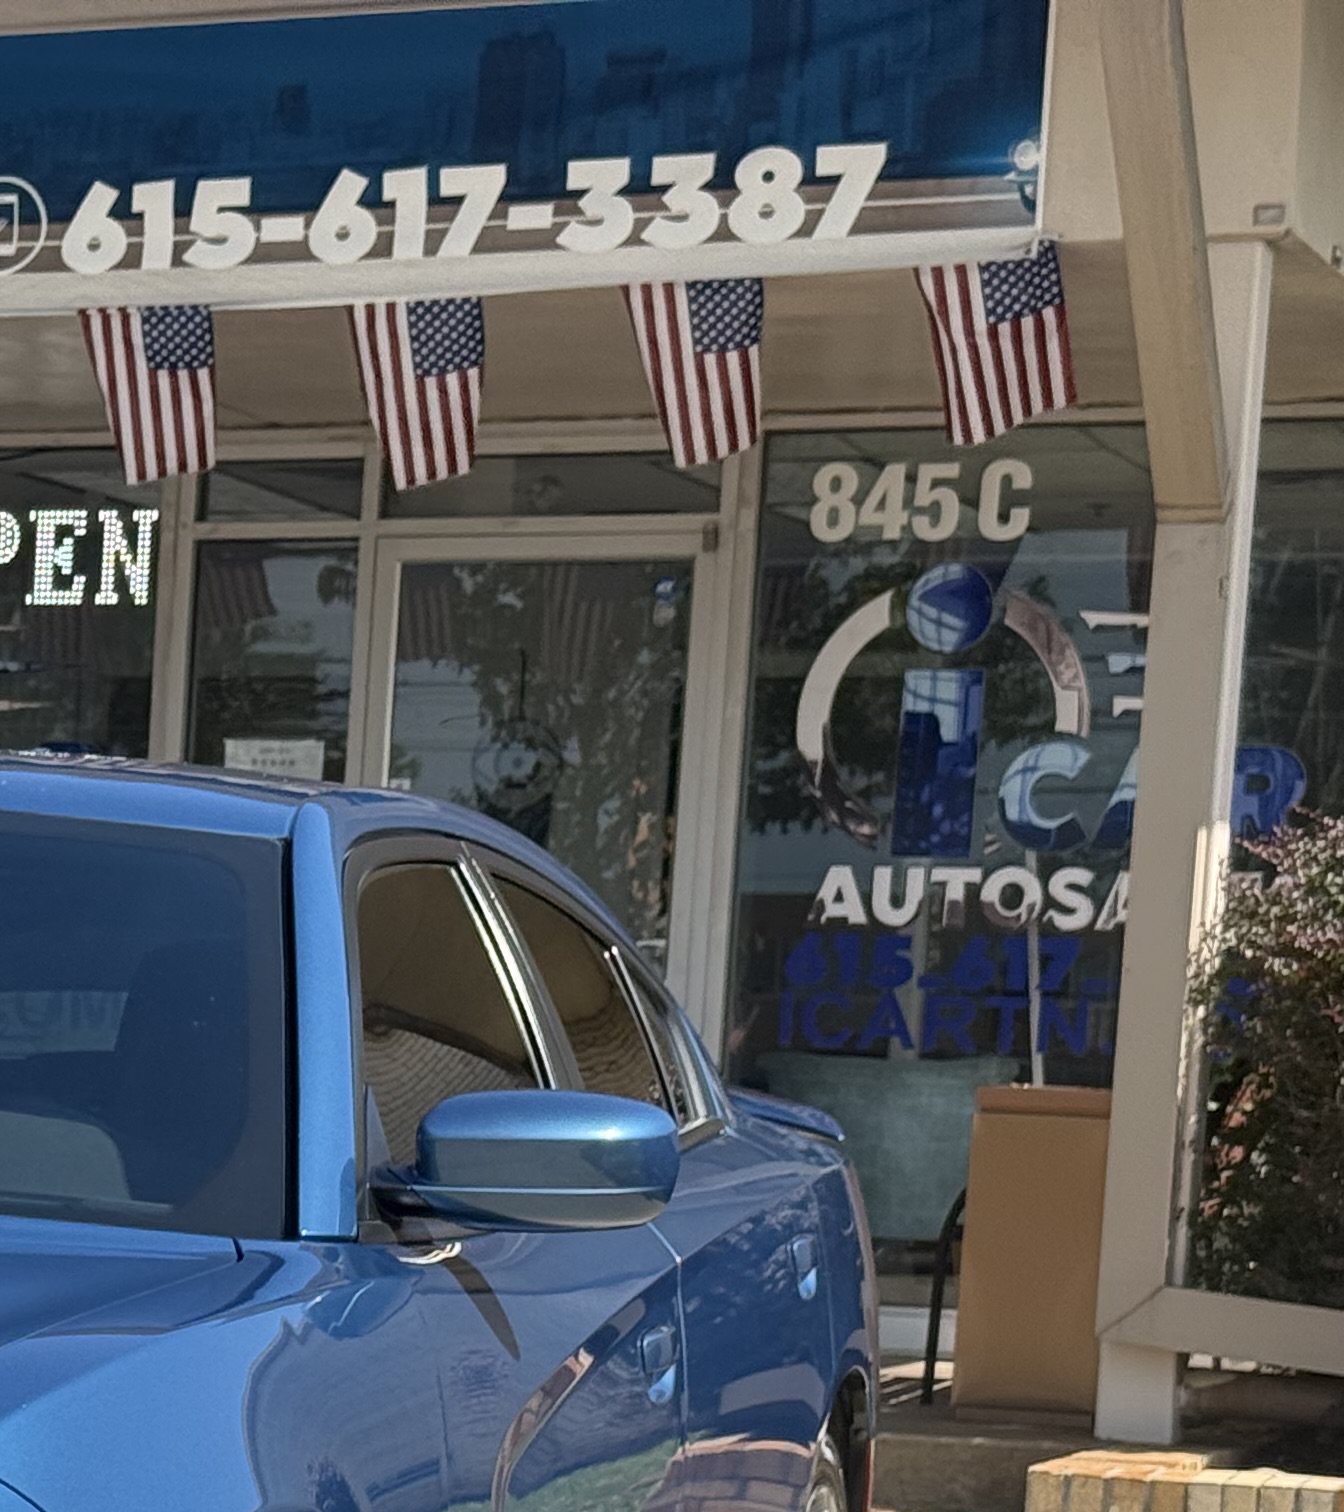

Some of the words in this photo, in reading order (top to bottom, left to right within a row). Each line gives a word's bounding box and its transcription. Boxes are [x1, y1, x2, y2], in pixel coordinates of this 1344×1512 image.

[60, 141, 889, 274] 615-617-3387
[809, 461, 962, 542] 845
[977, 457, 1033, 542] C
